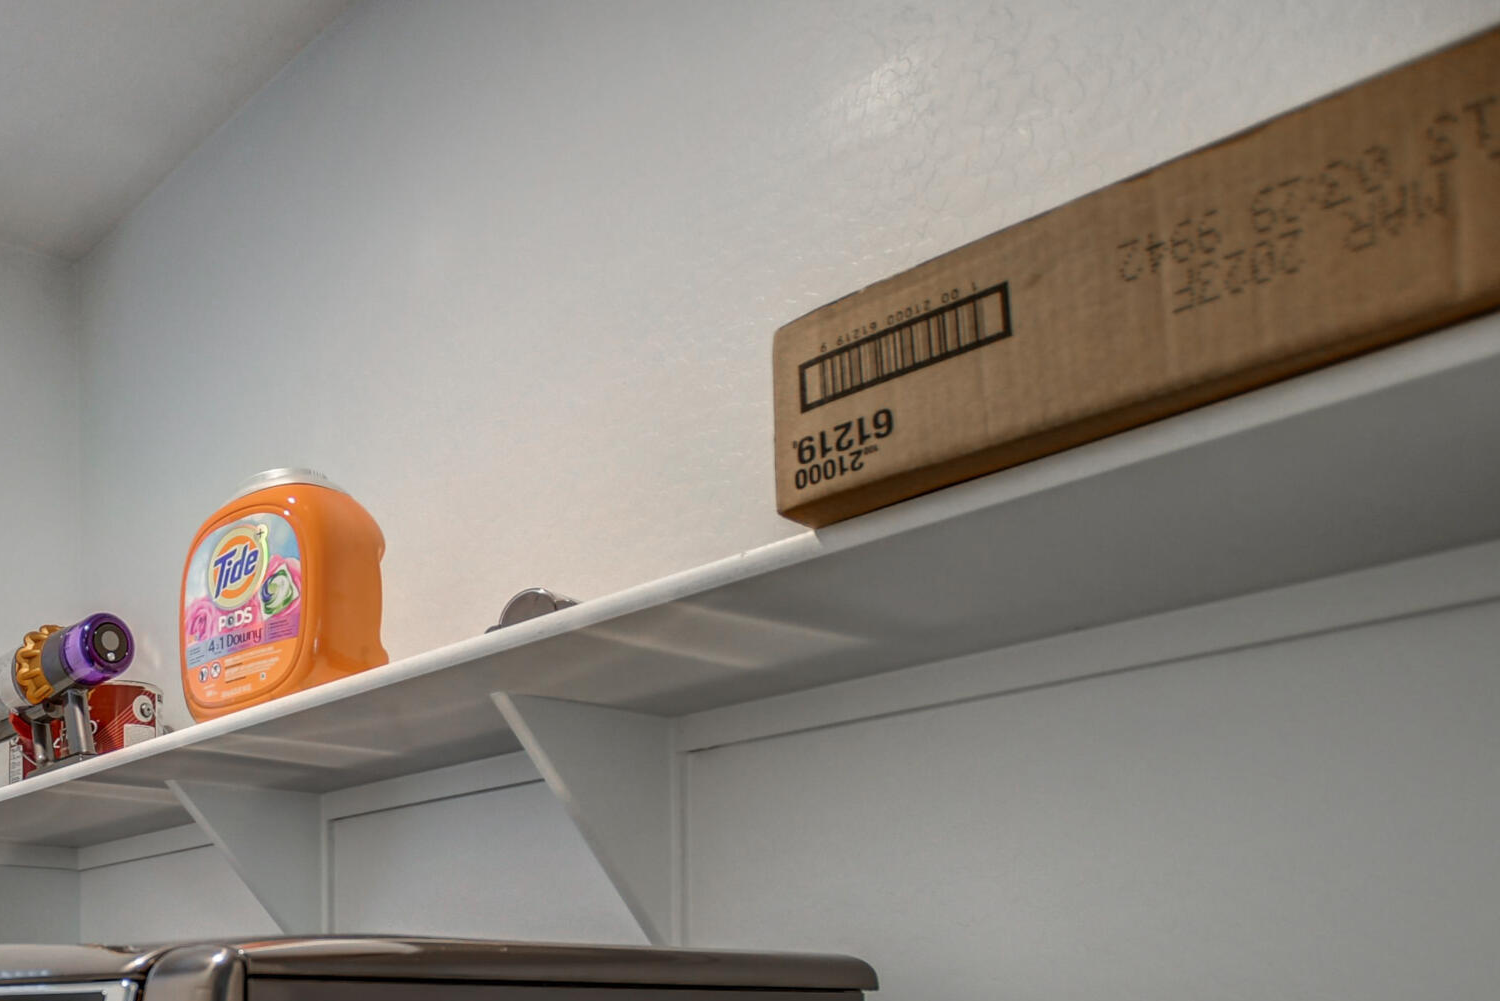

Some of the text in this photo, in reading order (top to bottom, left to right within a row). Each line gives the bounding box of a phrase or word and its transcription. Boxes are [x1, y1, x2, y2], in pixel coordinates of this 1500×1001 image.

[1117, 209, 1221, 282] 9942
[941, 289, 960, 304] 00
[887, 300, 931, 325] 21000
[836, 322, 877, 346] 61219
[797, 408, 894, 465] 61219
[795, 449, 864, 490] 21000
[214, 544, 259, 599] Tide
[218, 607, 253, 632] PODS
[227, 628, 262, 648] Downy
